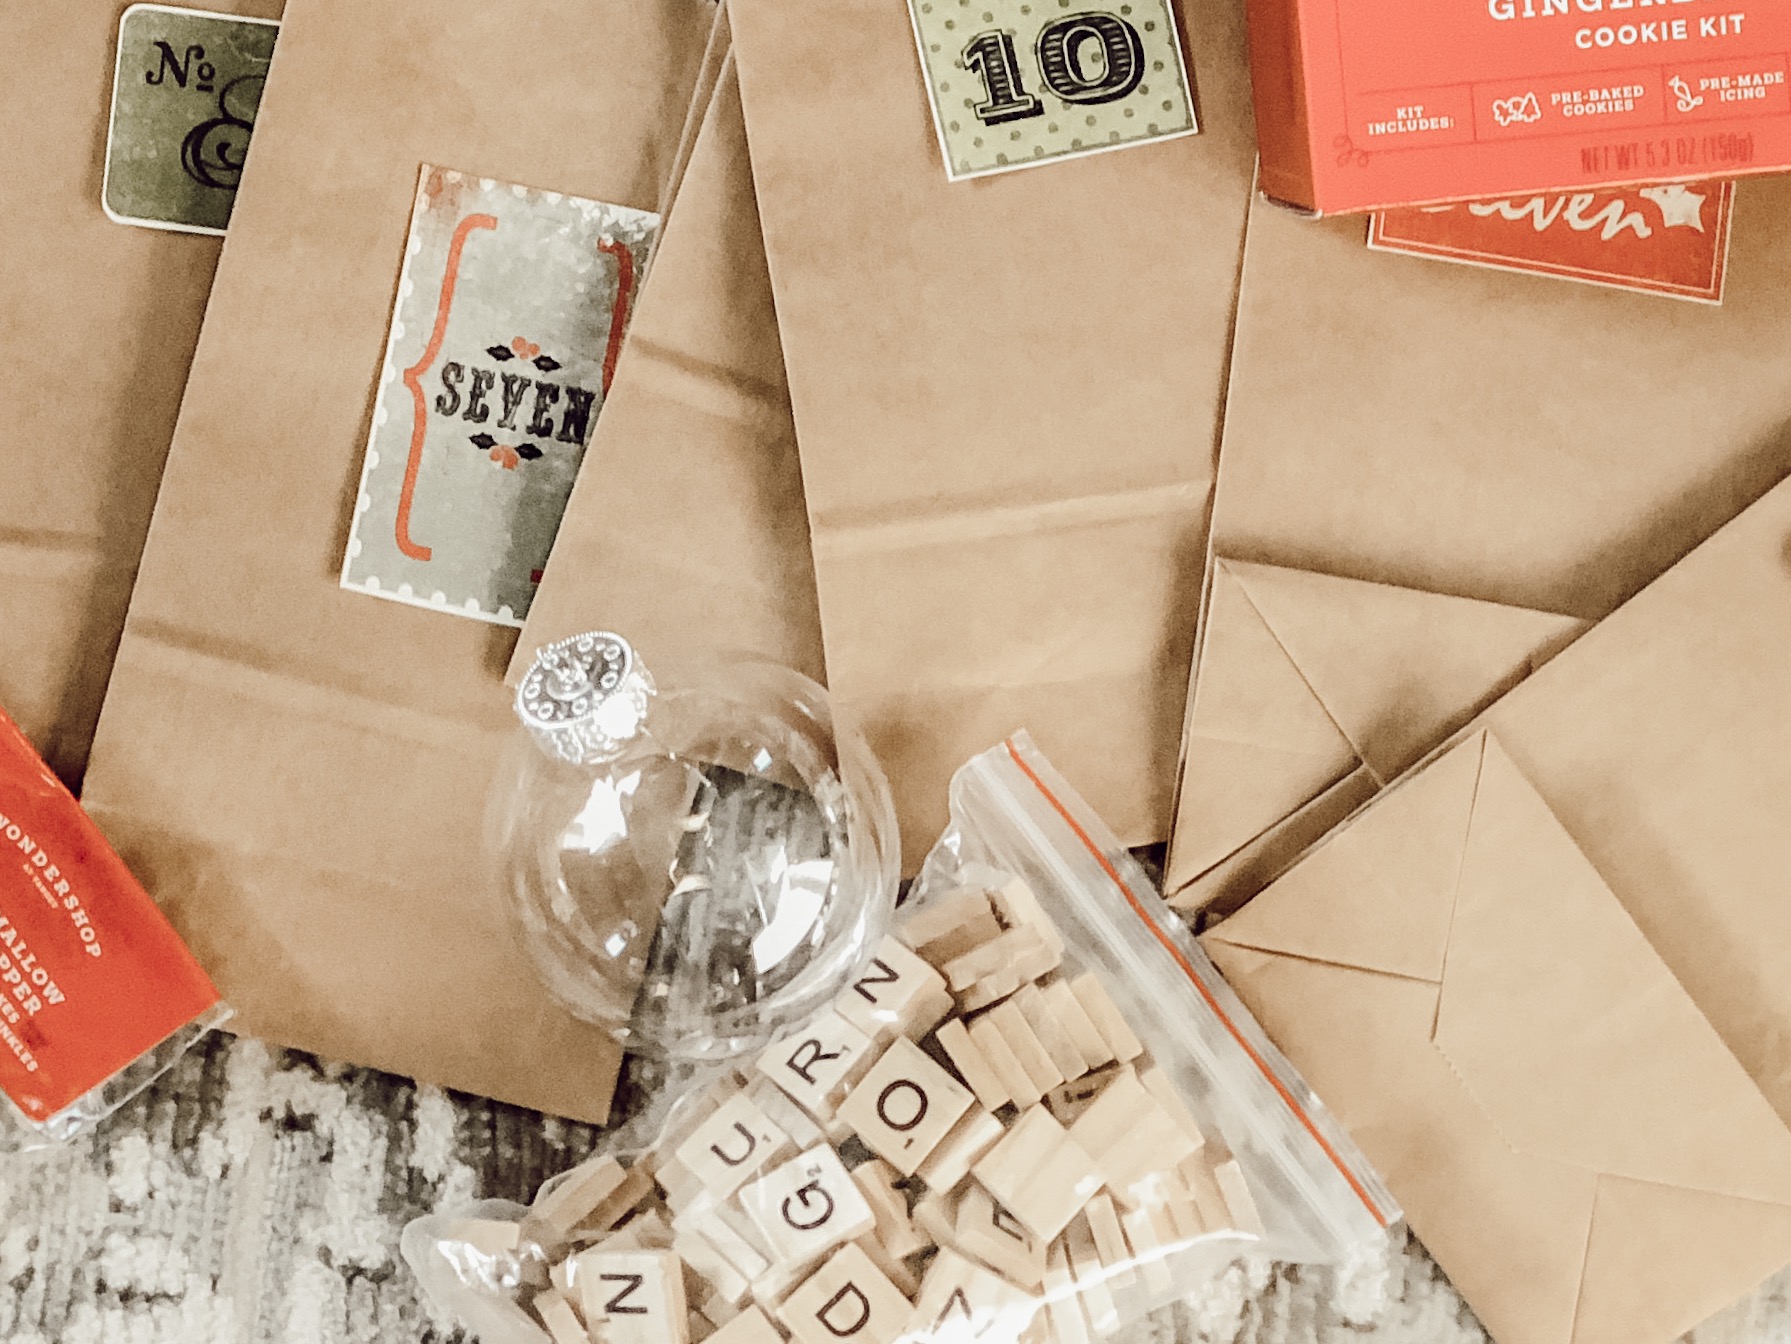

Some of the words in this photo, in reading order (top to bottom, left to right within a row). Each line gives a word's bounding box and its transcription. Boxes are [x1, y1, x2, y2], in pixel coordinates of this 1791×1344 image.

[1574, 18, 1688, 50] COOKIE
[1699, 13, 1746, 38] KIT
[960, 10, 1146, 127] 10
[1396, 105, 1425, 120] KIT
[1562, 98, 1635, 118] COOKIES
[1719, 85, 1766, 102] ICING
[1580, 144, 1609, 174] NET
[1614, 141, 1640, 172] WT
[435, 361, 597, 446] SEVEN
[785, 1038, 841, 1086] R
[876, 1078, 929, 1132] O
[710, 1121, 757, 1167] U
[781, 1178, 836, 1232] G
[814, 1280, 872, 1338] D
